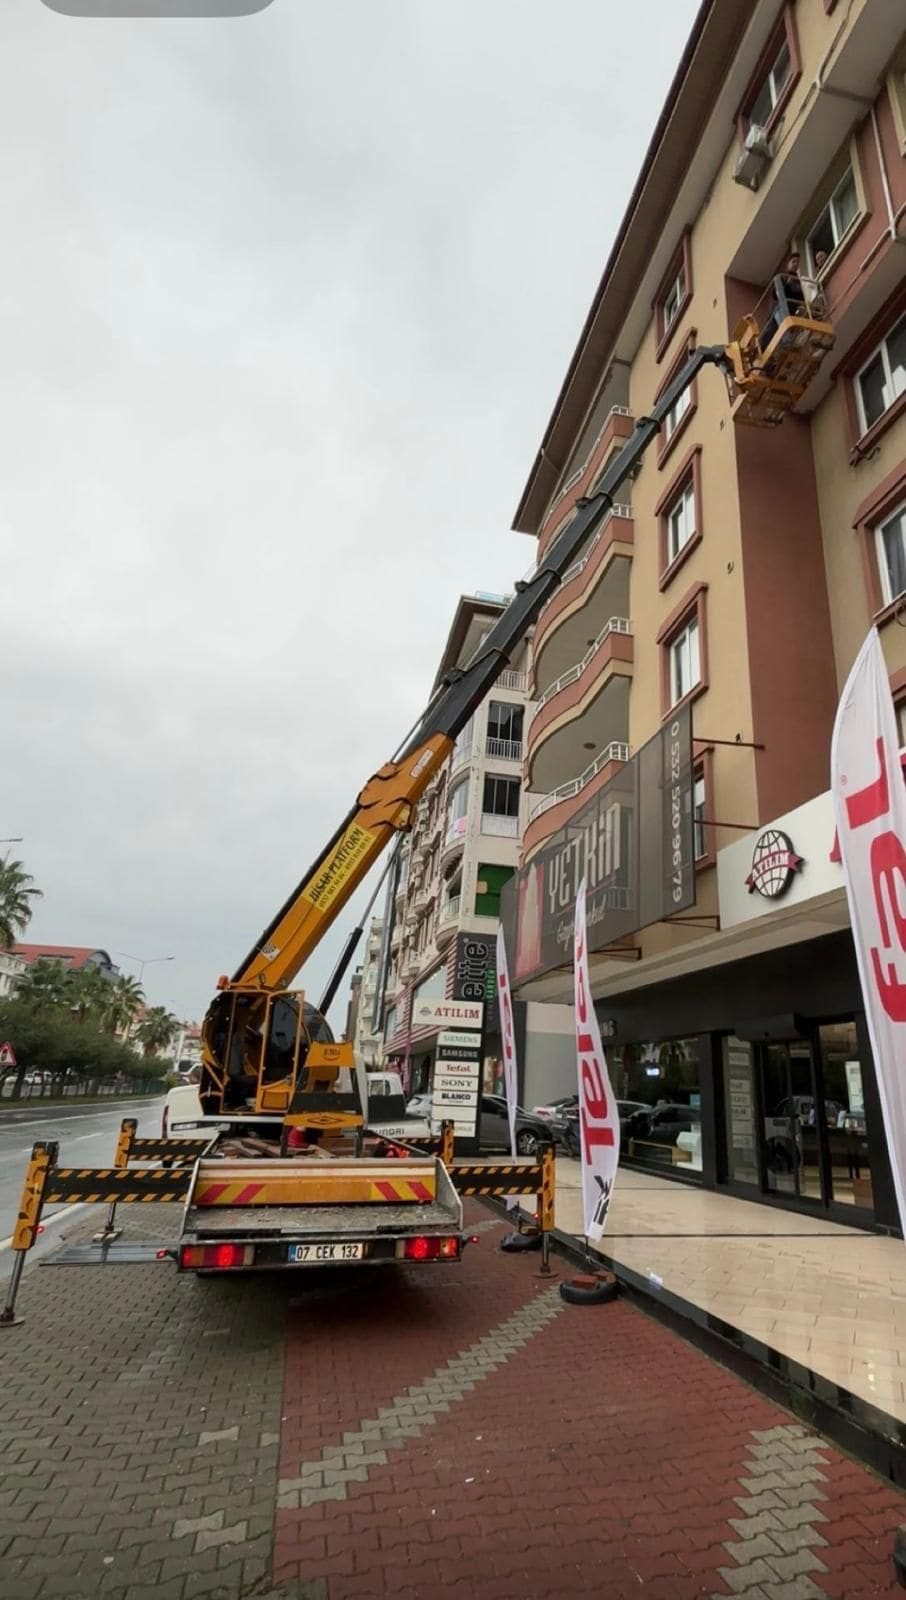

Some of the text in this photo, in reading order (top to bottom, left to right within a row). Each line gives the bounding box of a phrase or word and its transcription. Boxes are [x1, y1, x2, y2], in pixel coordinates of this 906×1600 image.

[671, 721, 682, 903] 0 532 520 96 79
[328, 828, 364, 876] PLATFORM
[434, 1007, 480, 1020] ATILIM
[443, 1034, 478, 1043] SIEMENS
[442, 1049, 478, 1058] SAMSUNG
[446, 1064, 471, 1072] Tefal
[441, 1079, 473, 1087] SONY
[441, 1093, 472, 1101] BLANCO
[297, 1245, 359, 1260] 07 CEK 132
